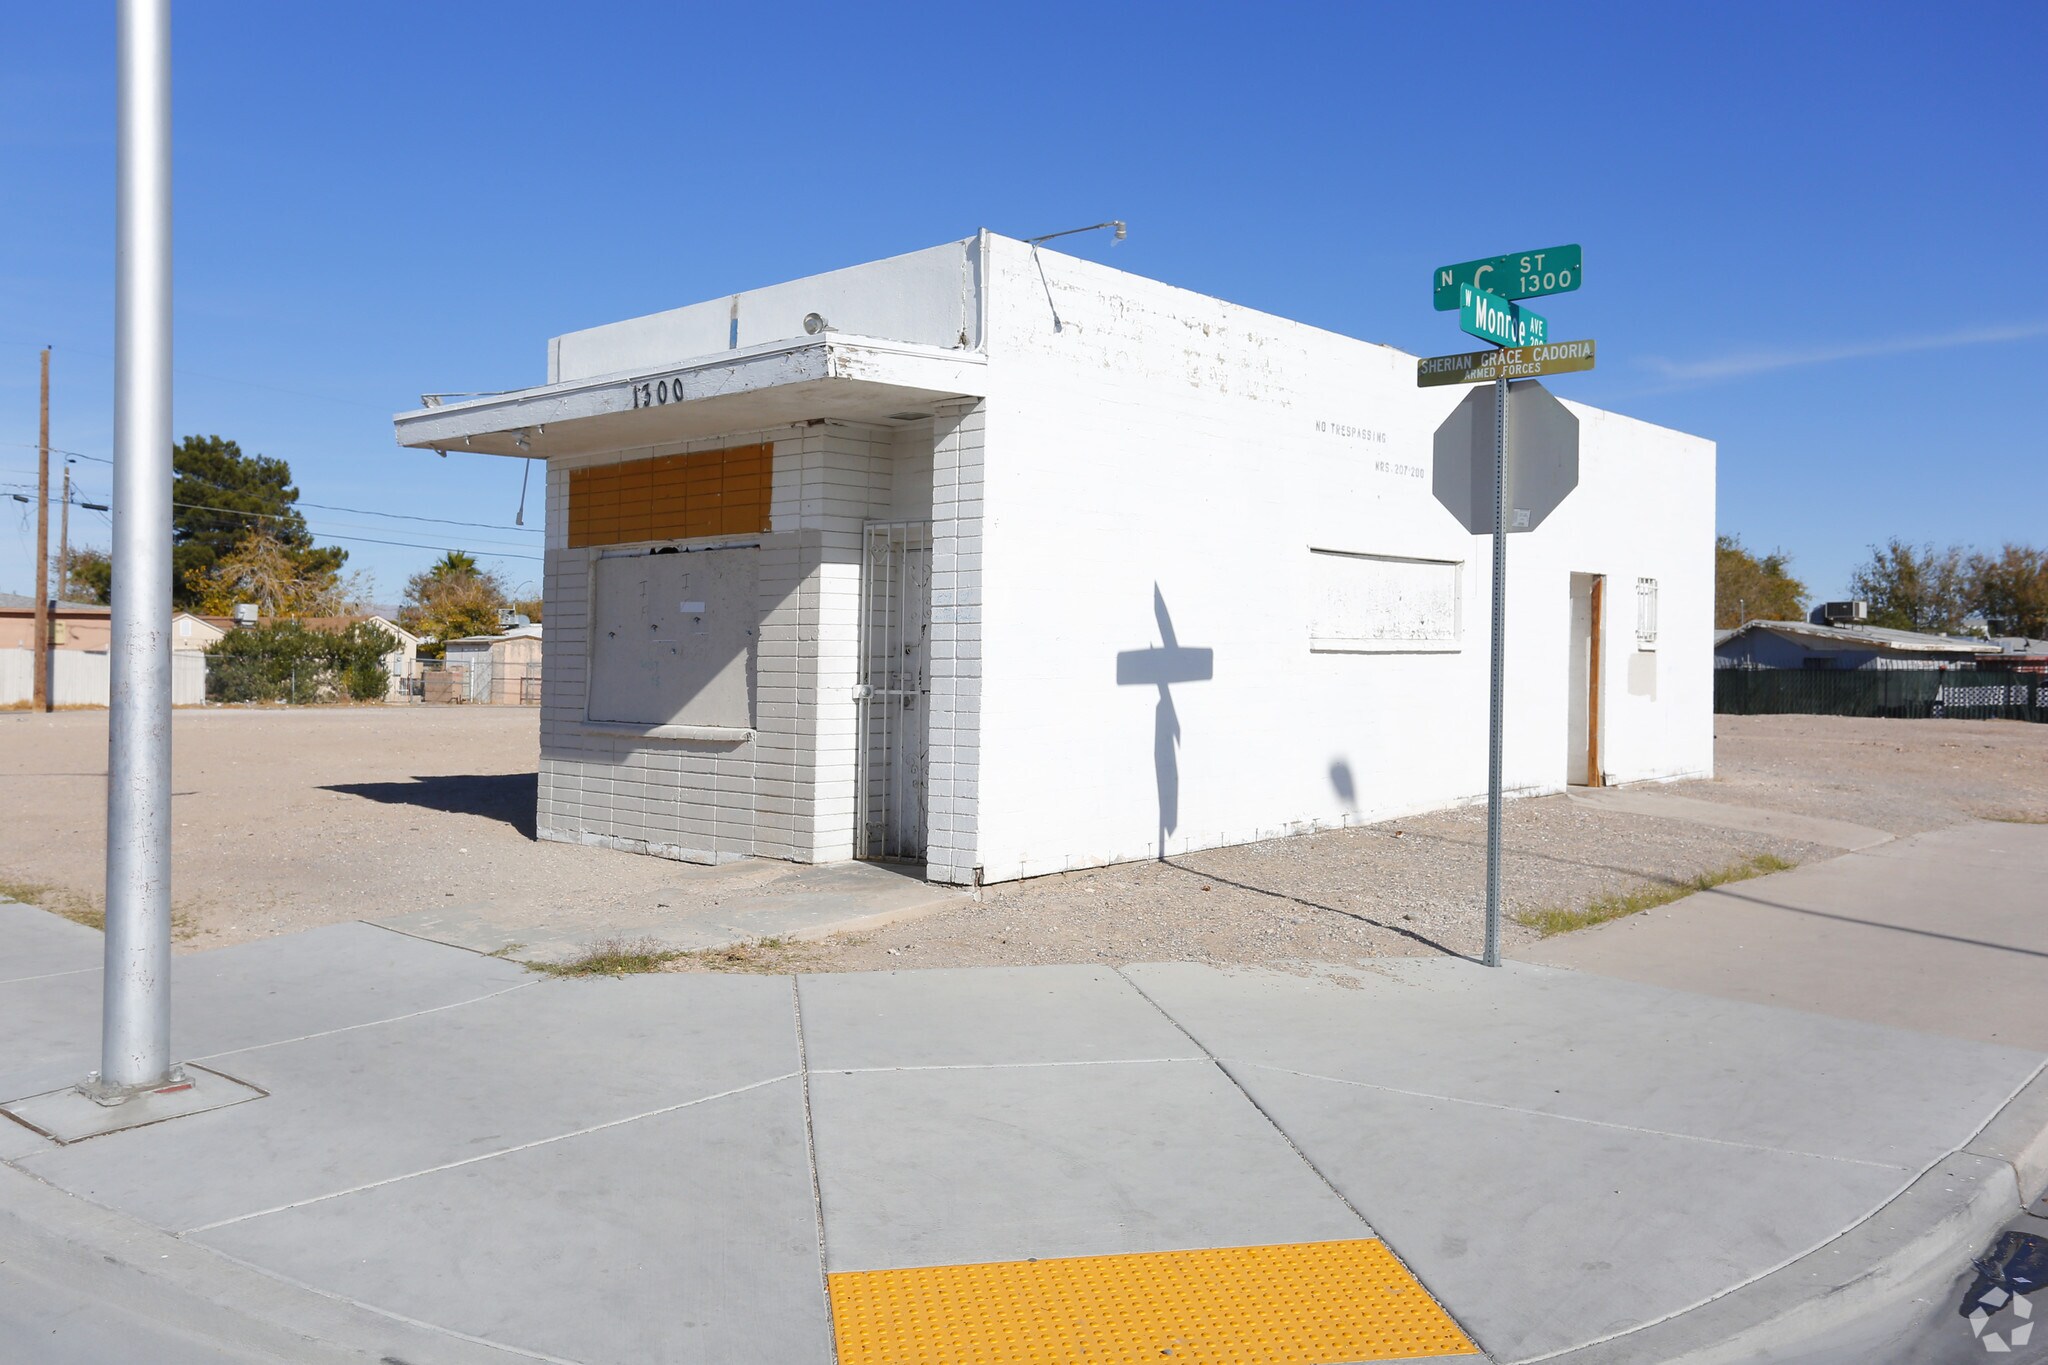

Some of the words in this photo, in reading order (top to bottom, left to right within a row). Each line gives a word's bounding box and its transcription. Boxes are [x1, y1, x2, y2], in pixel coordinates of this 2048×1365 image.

[1442, 270, 1452, 286] N
[1474, 265, 1494, 293] C
[1520, 254, 1545, 273] ST
[1520, 270, 1571, 293] 1300
[1465, 289, 1472, 307] W
[1476, 295, 1526, 346] Monroe
[1530, 317, 1543, 337] AVE
[1421, 356, 1472, 374] SHERIAN
[1481, 349, 1523, 367] GRACE
[1533, 342, 1591, 362] CADORIA
[1464, 368, 1496, 380] ARMED
[1502, 363, 1541, 377] FORCES
[633, 378, 683, 409] 1300
[1316, 420, 1326, 432] NO
[1331, 423, 1386, 443] TRESPASSING
